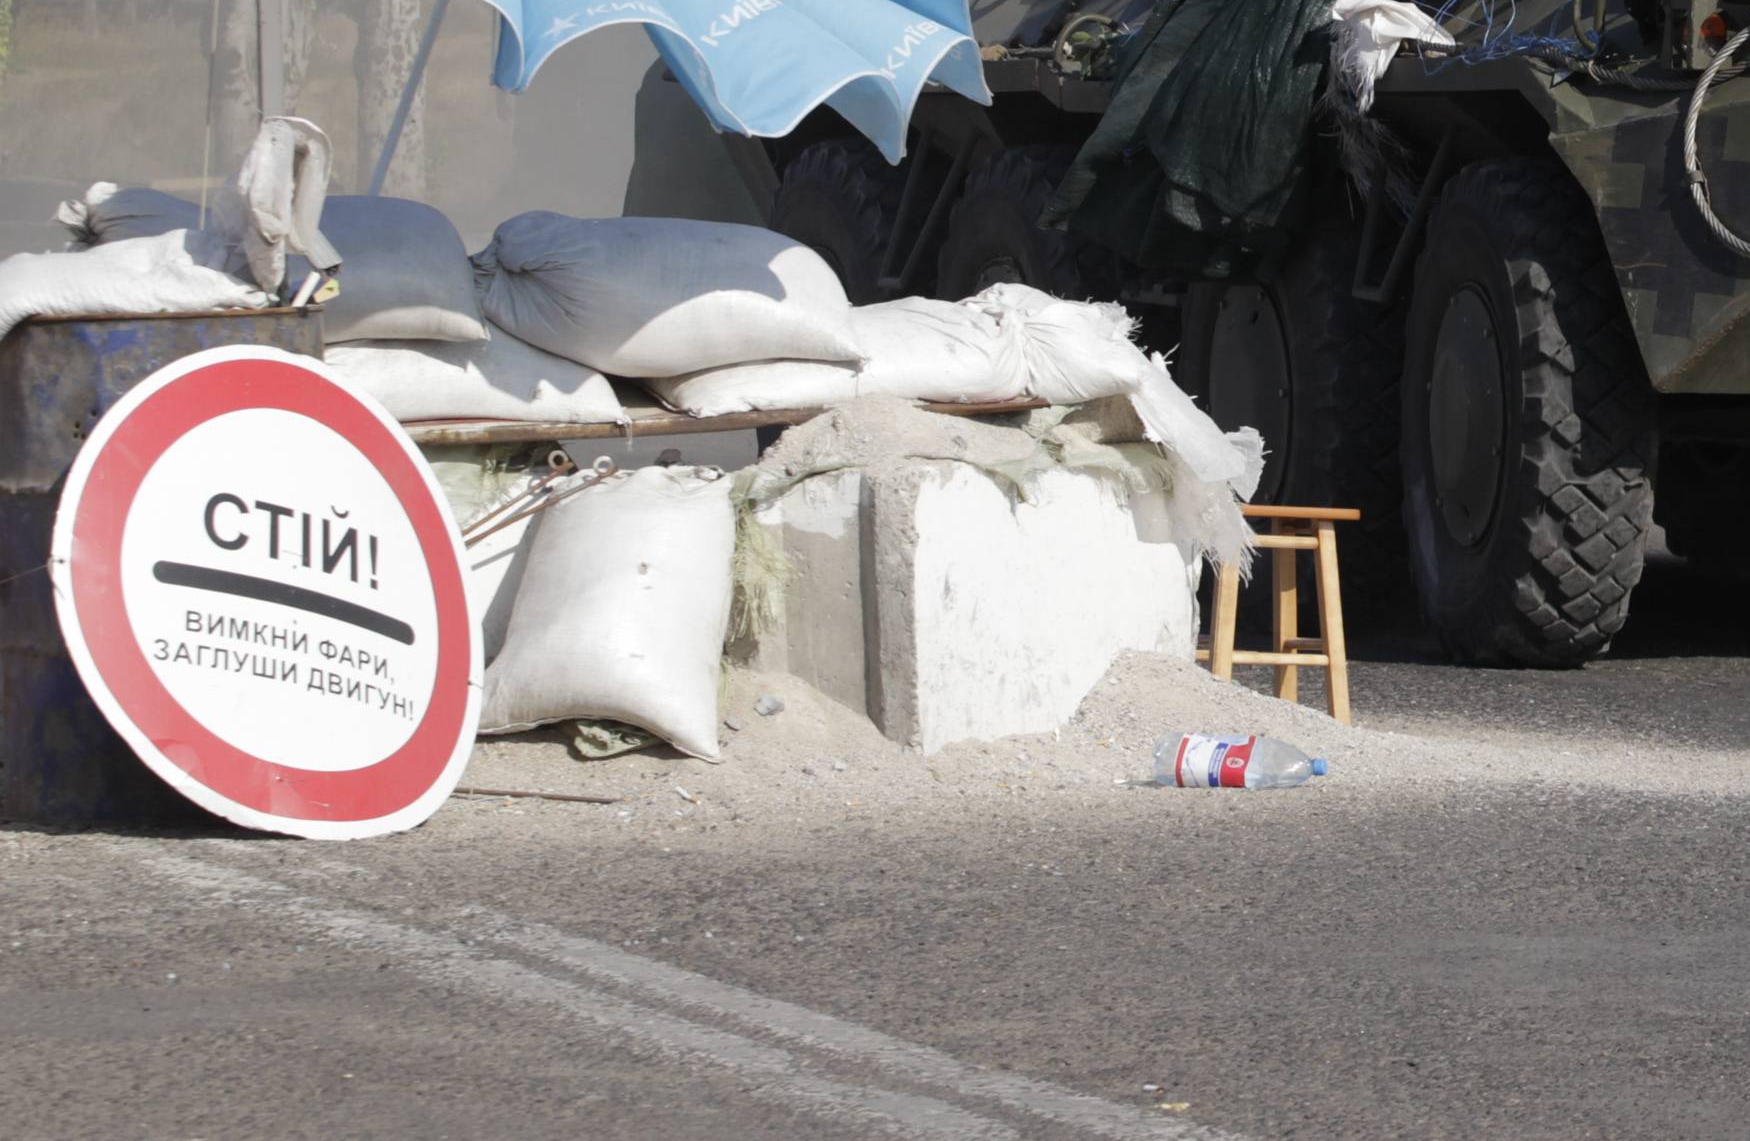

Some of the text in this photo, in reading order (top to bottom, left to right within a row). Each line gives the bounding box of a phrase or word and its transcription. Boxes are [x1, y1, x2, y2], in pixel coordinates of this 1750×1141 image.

[203, 492, 379, 590] СТІЙ!
[153, 638, 415, 721] ЗАГЛУШИ ДВИГУН!
[185, 610, 395, 686] ВИМКНИ ФАРИ,
